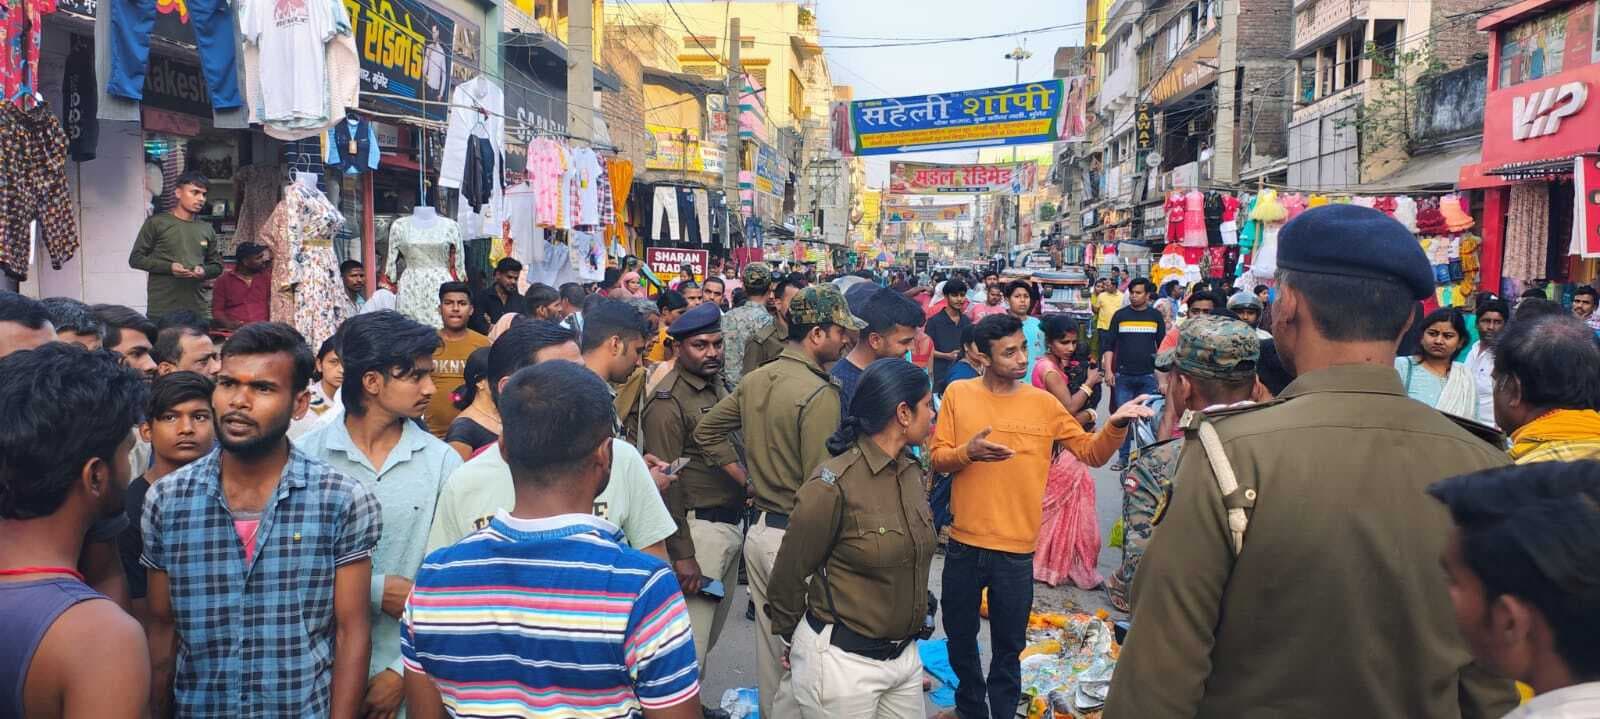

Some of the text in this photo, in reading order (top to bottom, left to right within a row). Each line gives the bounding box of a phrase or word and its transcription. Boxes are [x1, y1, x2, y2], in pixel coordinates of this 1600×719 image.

[861, 83, 1055, 127] सहेली शॉपी
[1512, 80, 1588, 142] VIP
[652, 262, 702, 274] TRADRS
[655, 251, 700, 263] SHARAN
